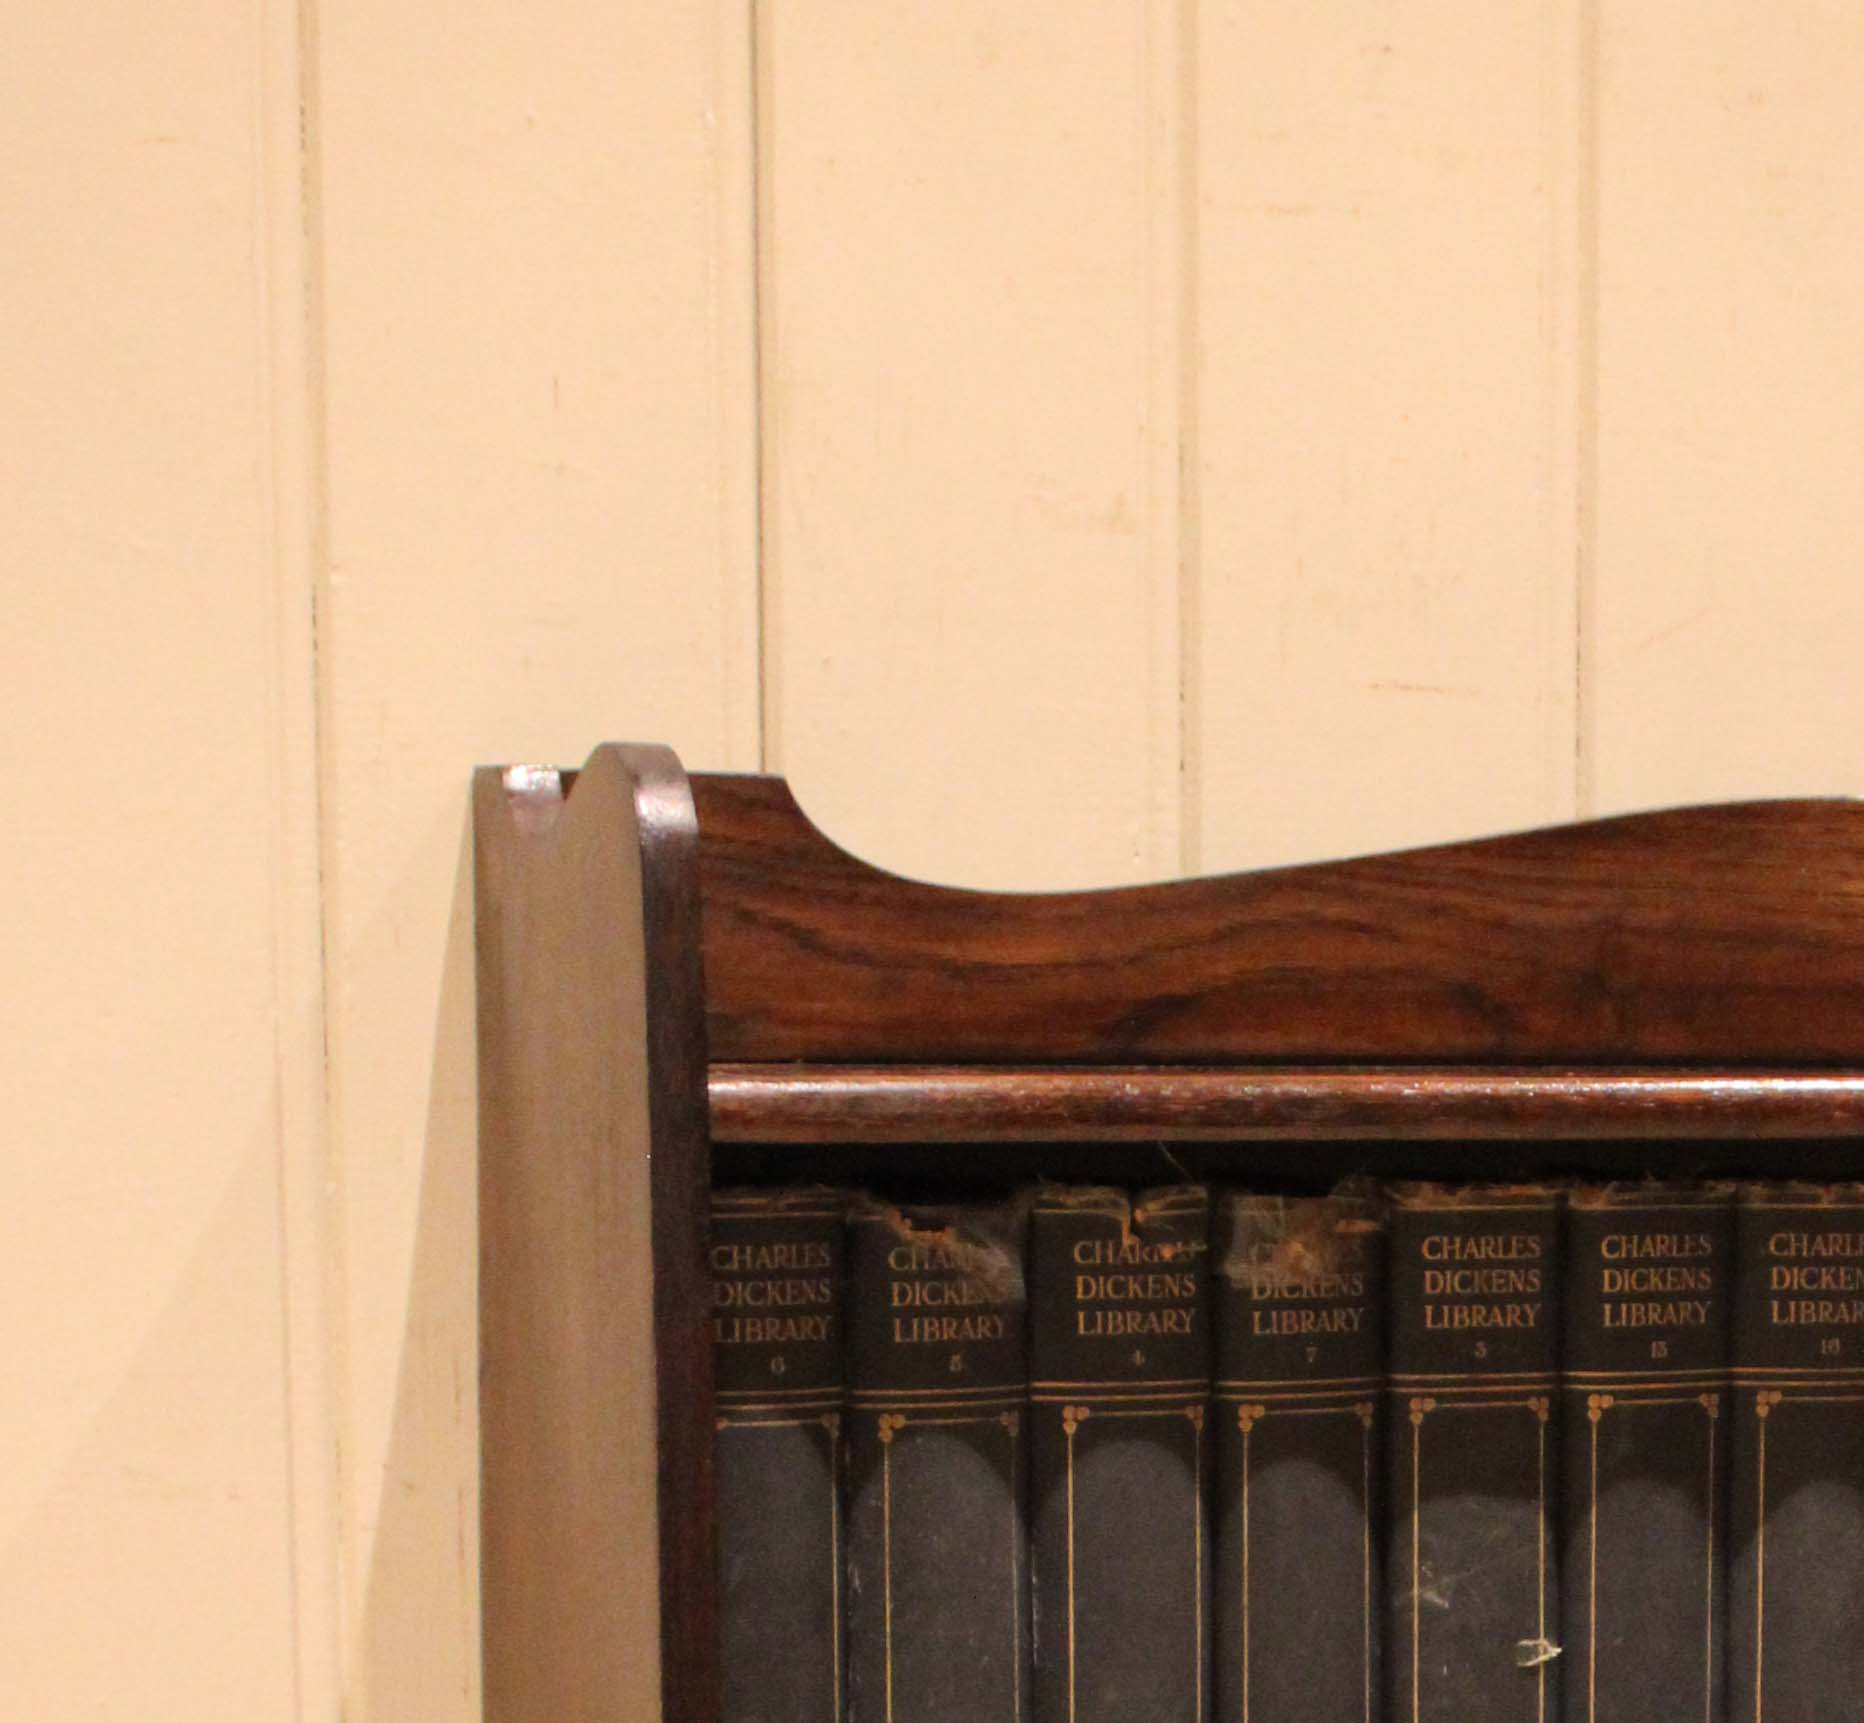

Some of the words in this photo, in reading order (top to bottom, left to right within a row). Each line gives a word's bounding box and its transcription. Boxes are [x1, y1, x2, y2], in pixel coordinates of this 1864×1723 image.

[1421, 1234, 1543, 1261] CHARLES
[1601, 1233, 1713, 1261] CHARLES
[713, 1277, 833, 1307] DICKENS
[1076, 1273, 1197, 1300] DICKENS
[1424, 1269, 1542, 1296] DICKENS
[1602, 1267, 1713, 1295] DICKENS
[715, 1313, 833, 1344] LIBRARY
[1077, 1307, 1197, 1337] LIBRARY
[1253, 1307, 1365, 1336] LIBRARY
[1424, 1304, 1542, 1331] LIBRARY
[1603, 1302, 1713, 1330] LIBRARY
